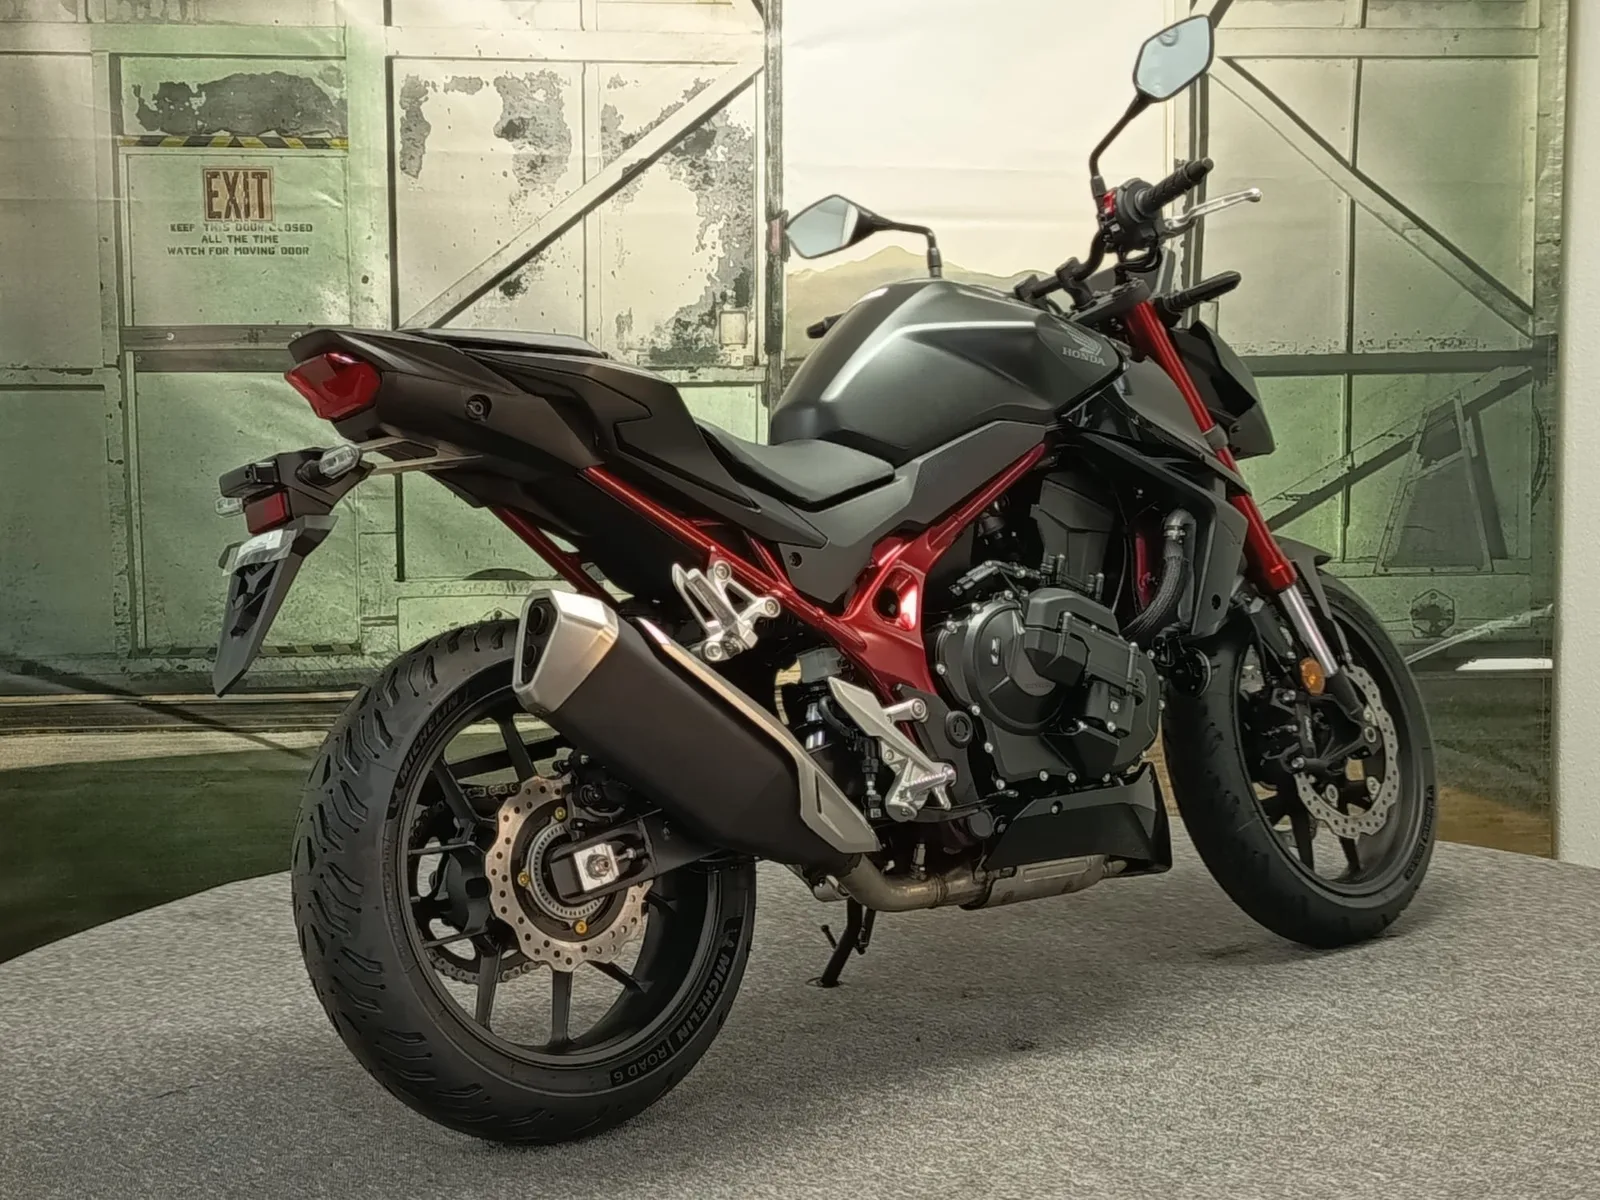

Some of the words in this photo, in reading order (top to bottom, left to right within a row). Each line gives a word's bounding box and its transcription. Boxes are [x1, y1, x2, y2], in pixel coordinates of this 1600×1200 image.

[206, 171, 268, 219] EXIT
[170, 223, 195, 232] KEEP
[203, 222, 230, 232] THS
[201, 235, 222, 244] ALL
[227, 235, 248, 244] THE
[252, 235, 279, 244] TIME
[167, 246, 205, 255] WATCH
[209, 246, 229, 255] FOR
[234, 246, 275, 255] MOVING
[281, 246, 309, 255] DOOR
[1062, 346, 1106, 366] HONDA
[399, 692, 459, 783] MICHELIN
[676, 953, 730, 1042] MICHELIN
[628, 1042, 668, 1077] ROAD
[613, 1071, 624, 1083] 6
